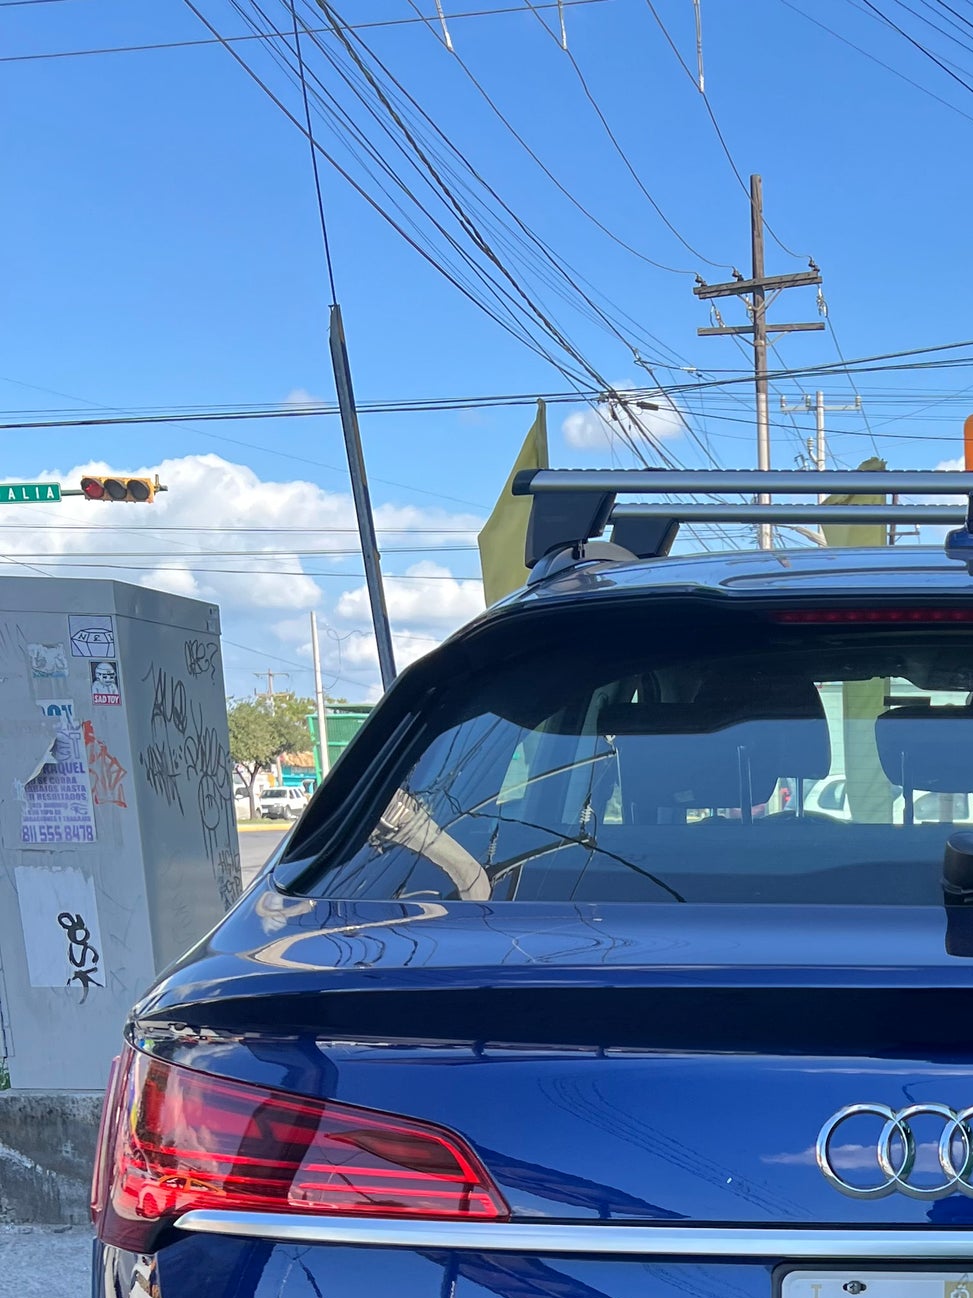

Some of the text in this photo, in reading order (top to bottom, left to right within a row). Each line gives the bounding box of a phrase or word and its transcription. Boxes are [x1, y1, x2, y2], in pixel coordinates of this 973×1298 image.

[94, 694, 120, 704] SAD TOY
[64, 825, 93, 841] 8478
